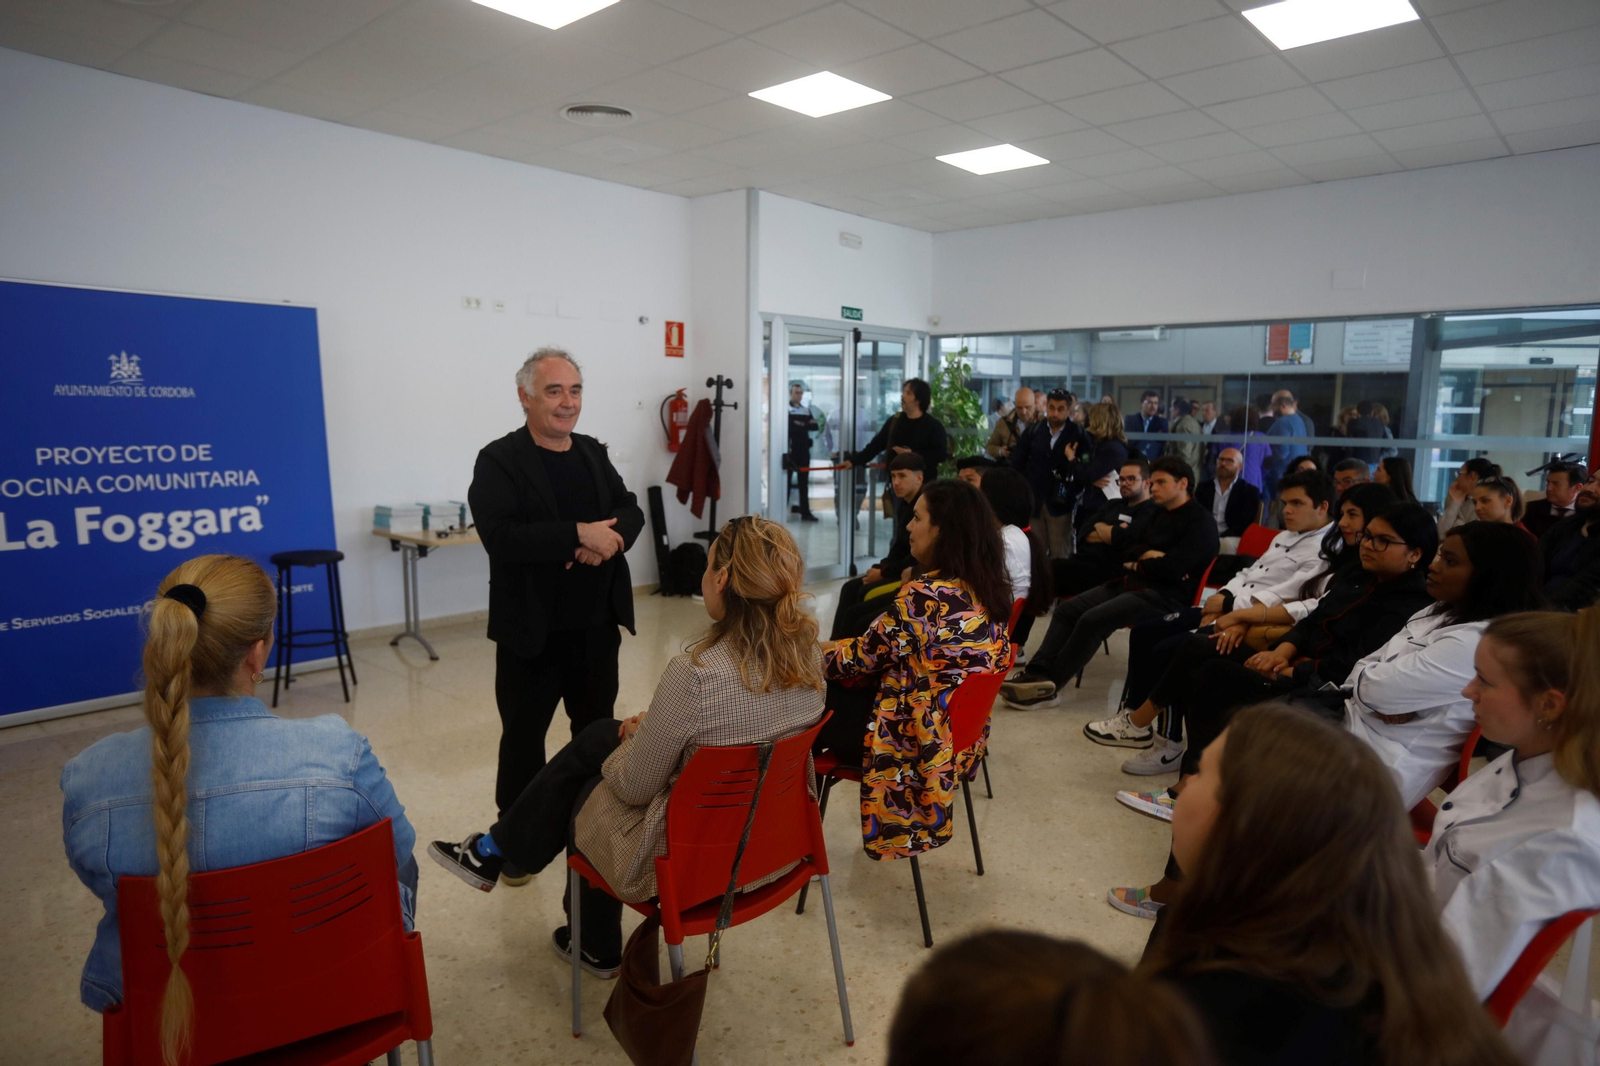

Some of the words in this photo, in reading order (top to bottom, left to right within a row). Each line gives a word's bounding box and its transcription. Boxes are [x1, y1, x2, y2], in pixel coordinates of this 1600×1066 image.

[54, 384, 132, 397] AYUNTAMIENTO
[134, 386, 147, 397] DE
[36, 445, 176, 465] PROYECTO
[181, 444, 212, 462] DE
[0, 477, 93, 498] OCINA
[96, 470, 260, 493] COMUNITARIA
[0, 511, 59, 551] La
[0, 622, 9, 631] E
